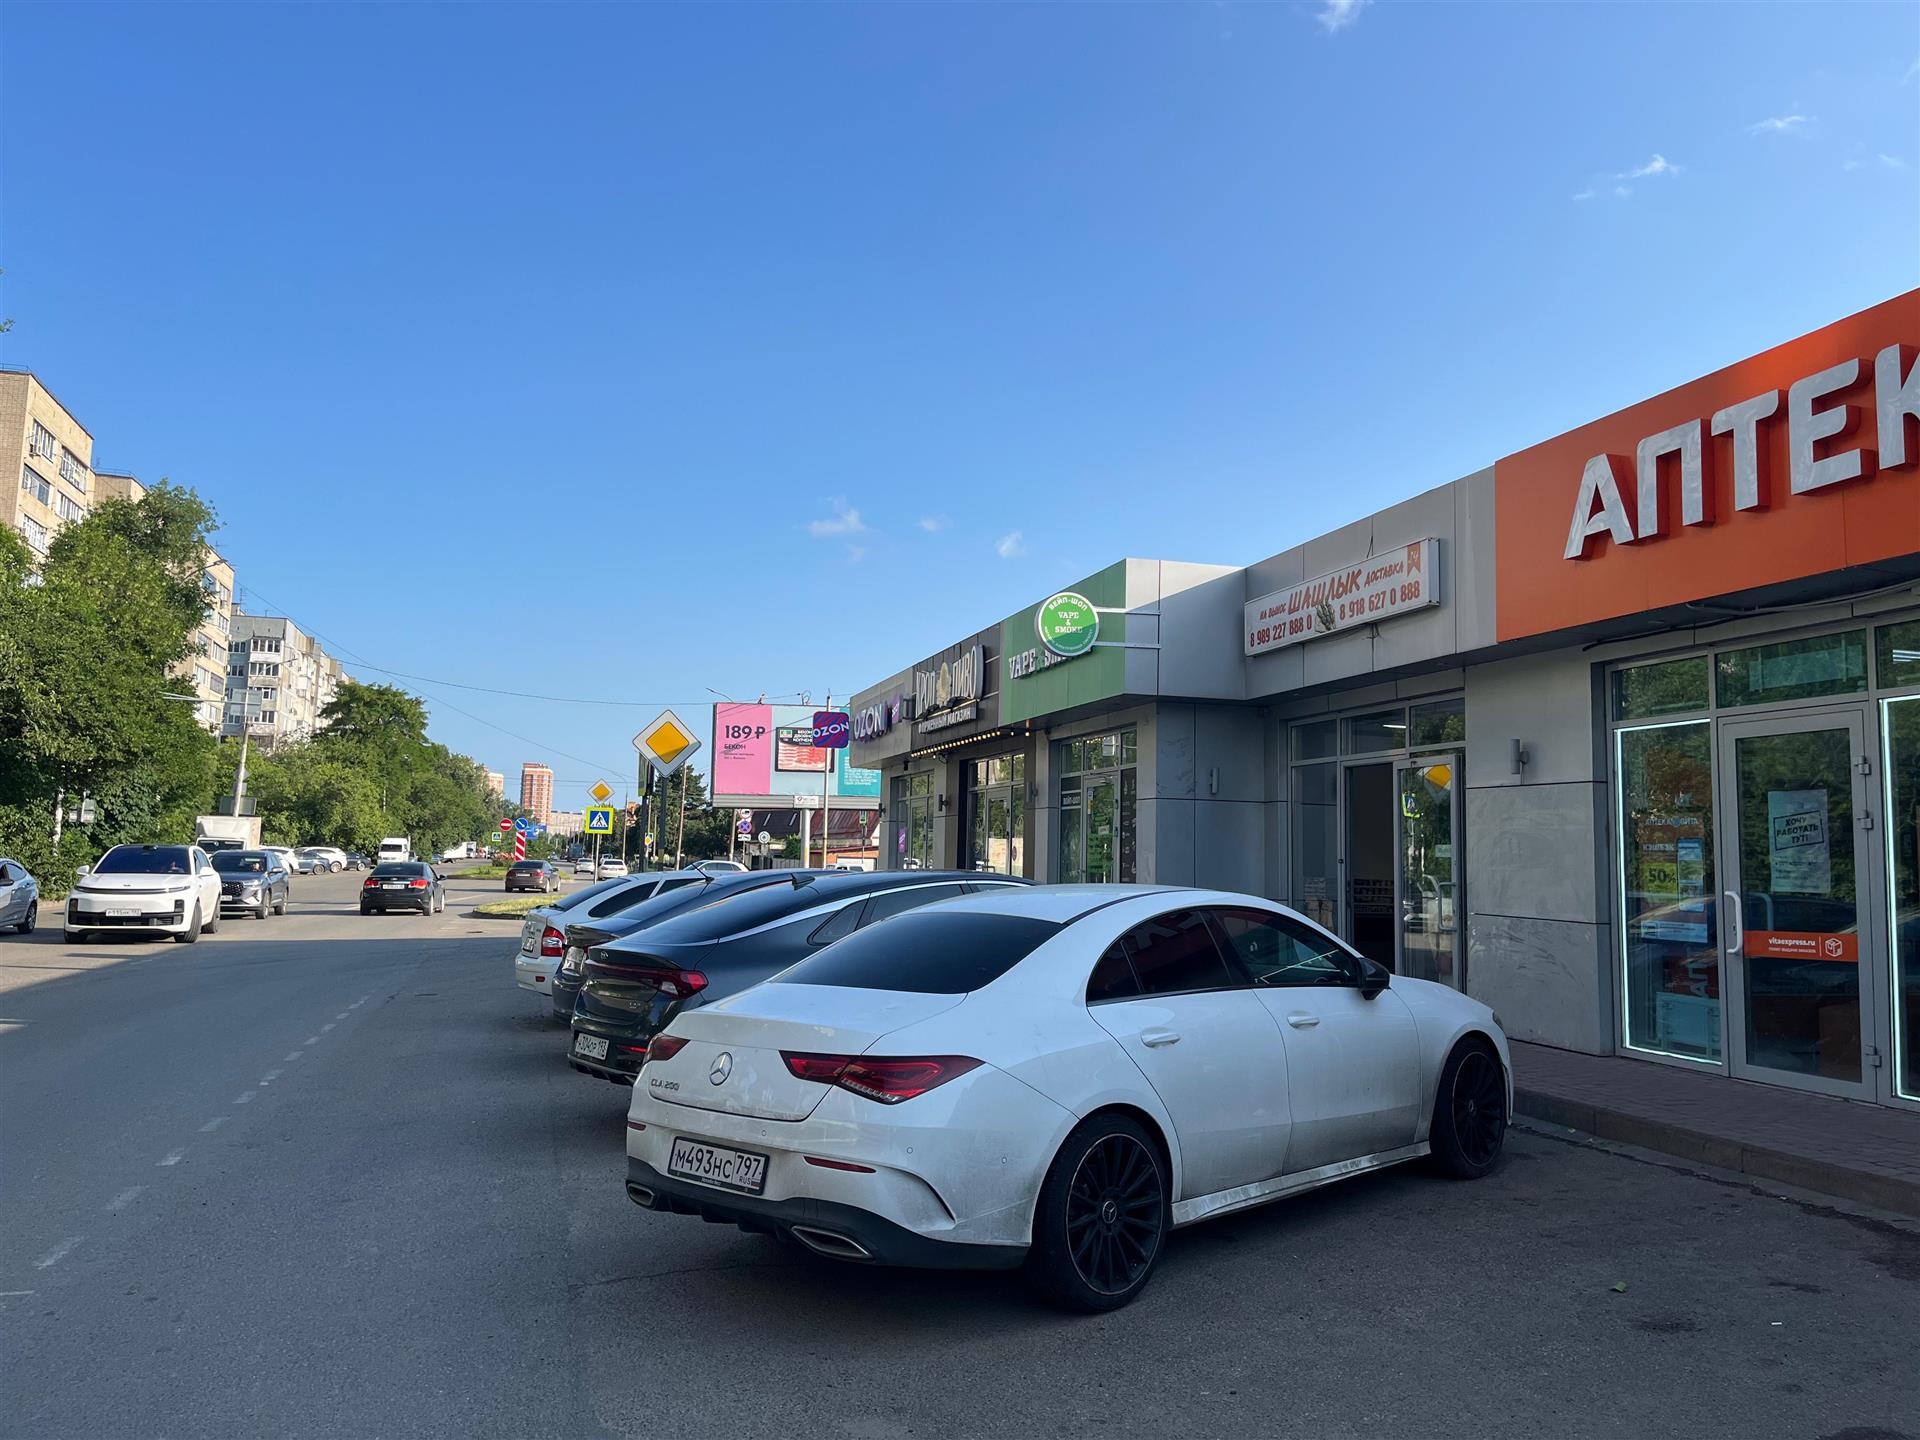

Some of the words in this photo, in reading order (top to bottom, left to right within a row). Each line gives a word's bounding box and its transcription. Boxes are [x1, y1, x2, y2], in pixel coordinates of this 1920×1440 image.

[1287, 568, 1362, 615] ШАШЛЫК
[1364, 561, 1404, 588] ДОСТАВКА
[1339, 602, 1345, 620] 8
[1348, 597, 1365, 618] 918
[1369, 591, 1386, 611] 627
[1390, 589, 1396, 606] 0
[1400, 580, 1420, 601] 888
[1058, 611, 1079, 619] VAPE
[1250, 631, 1255, 647] 8
[1257, 627, 1270, 646] 989
[1273, 624, 1286, 641] 227
[1289, 618, 1303, 636] 888
[1307, 617, 1312, 631] 0
[1008, 648, 1036, 679] VAPE
[854, 703, 883, 740] OZON
[725, 725, 752, 739] 189
[813, 722, 850, 738] OZON
[1785, 817, 1807, 827] ХОЧУ
[1776, 824, 1819, 837] РАБОТАТЬ
[1768, 937, 1816, 946] vitaexpress.ru
[650, 1078, 663, 1087] CLA
[664, 1081, 680, 1091] 200
[736, 1154, 761, 1178] 797
[739, 1176, 751, 1185] RUS
